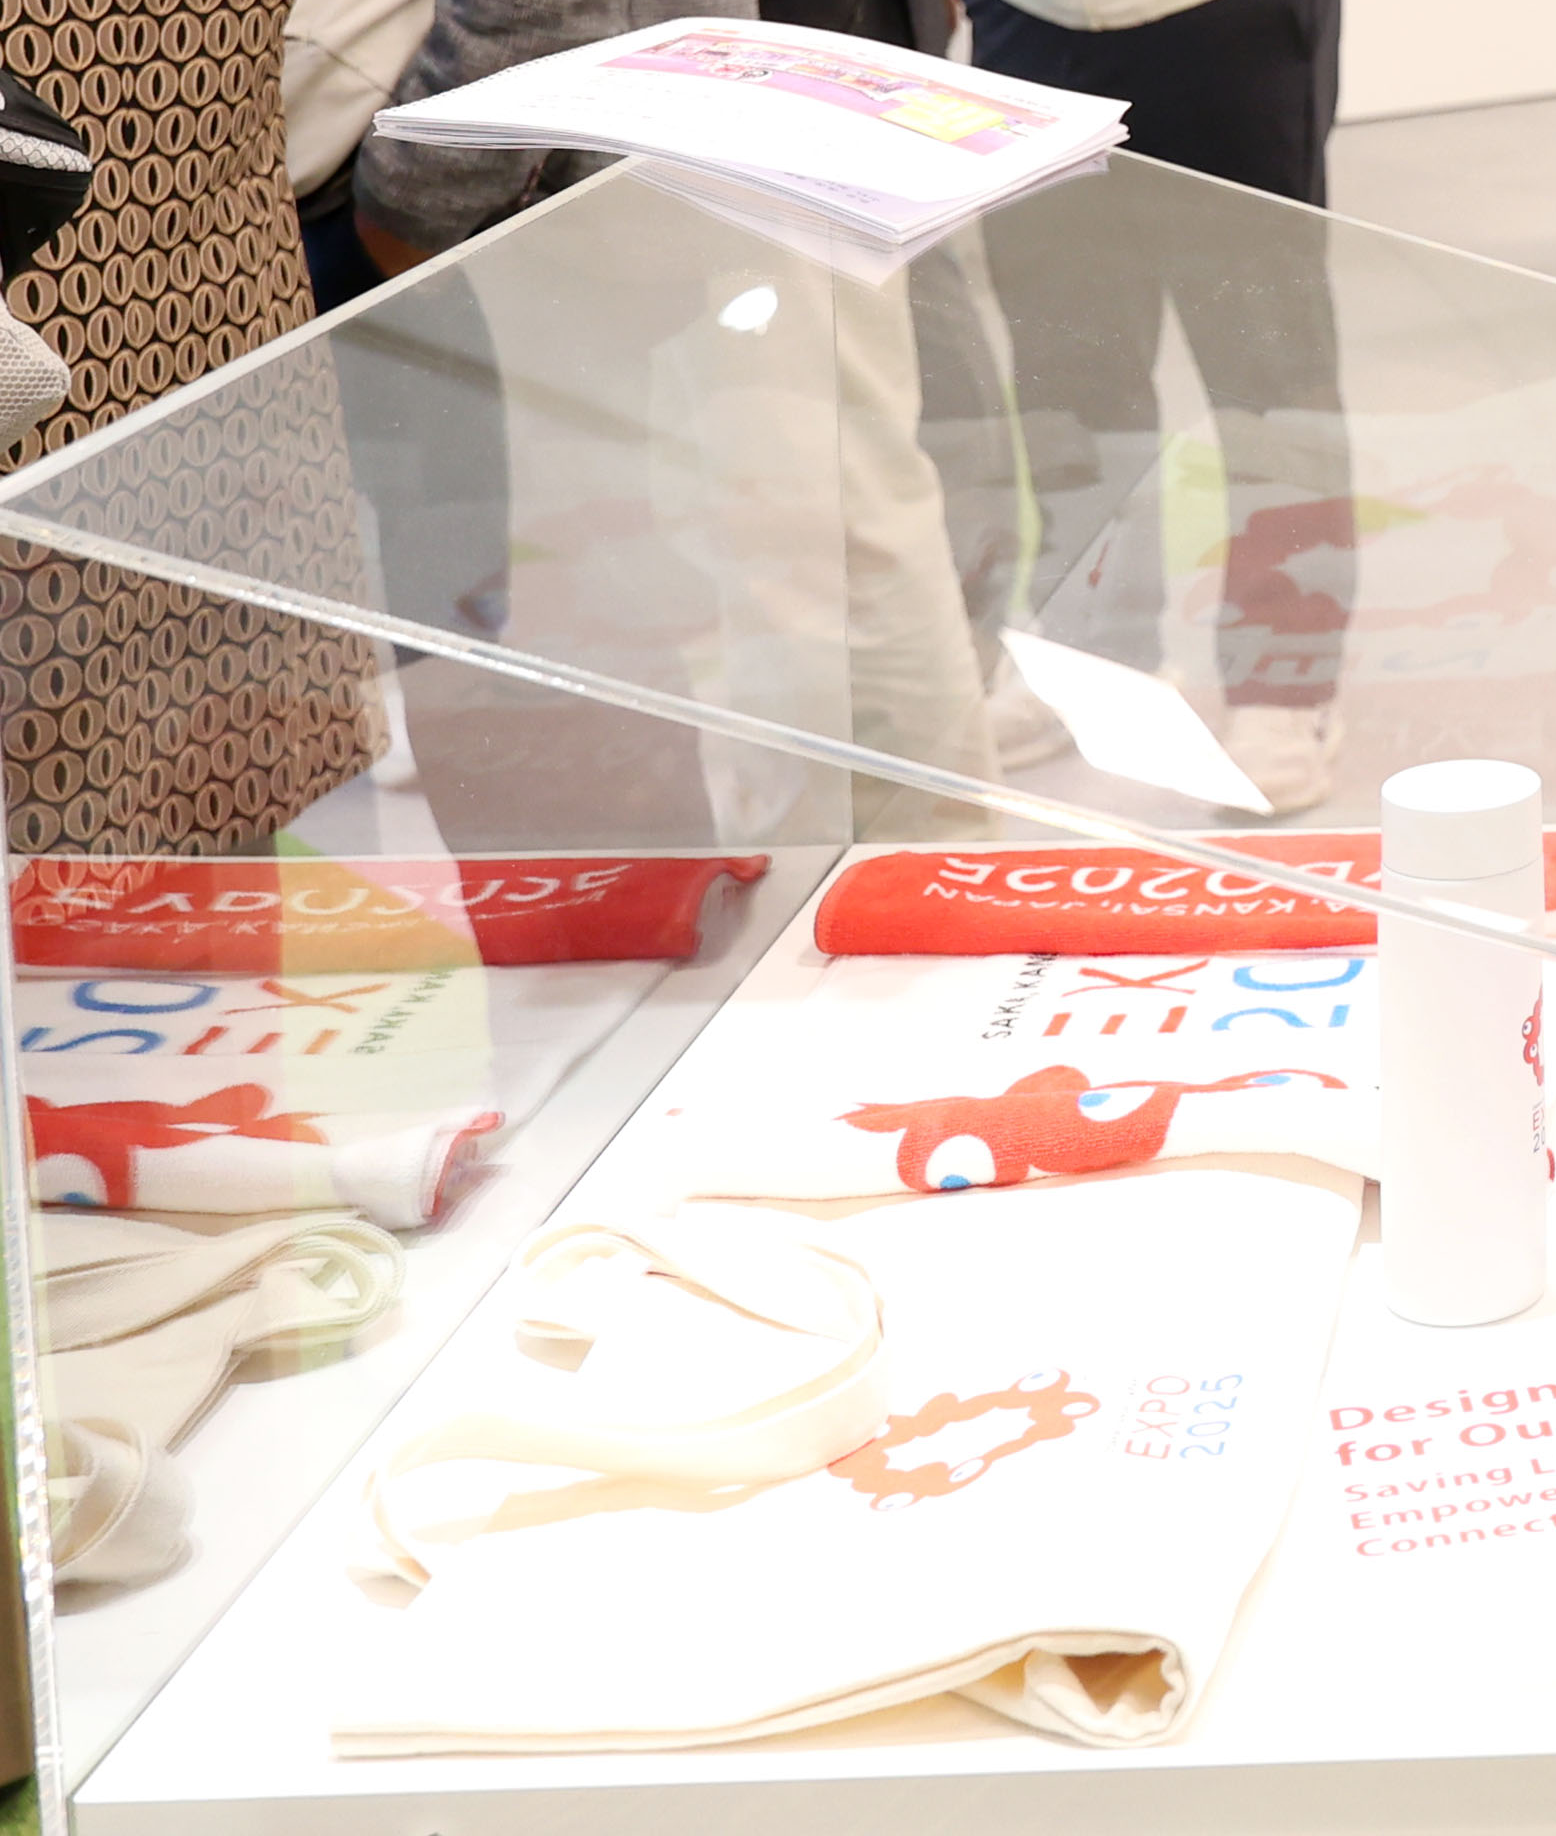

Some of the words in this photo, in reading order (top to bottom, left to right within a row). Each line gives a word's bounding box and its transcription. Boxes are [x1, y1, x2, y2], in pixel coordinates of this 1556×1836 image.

[1124, 1375, 1191, 1459] EXPO
[1179, 1374, 1243, 1459] 2025
[1334, 1435, 1433, 1466] for
[1343, 1463, 1513, 1503] Saving
